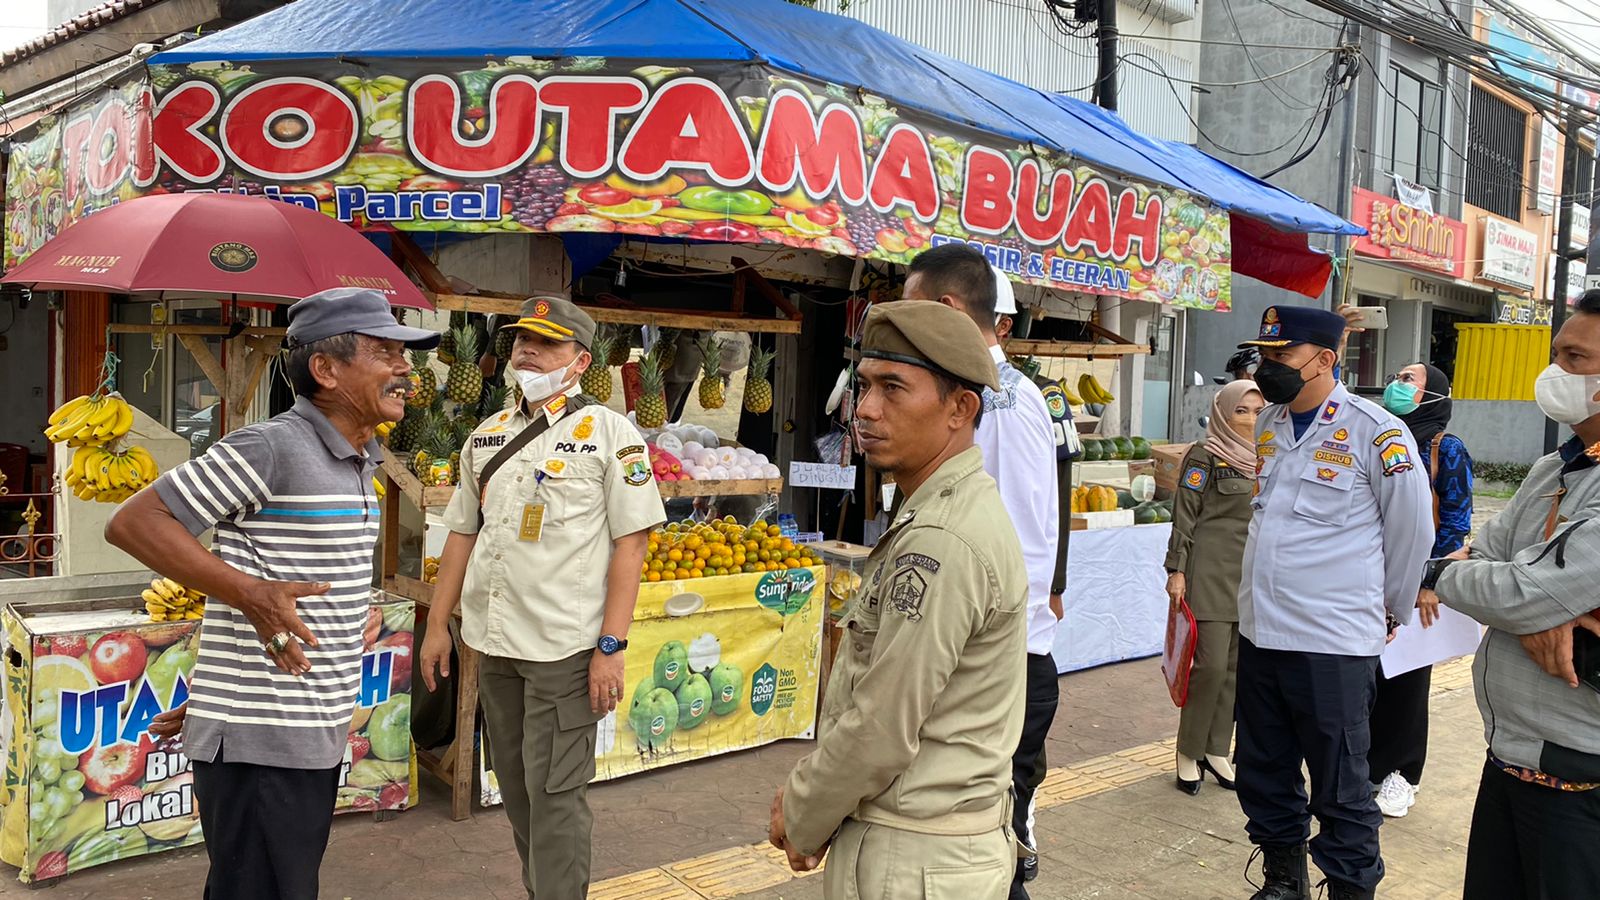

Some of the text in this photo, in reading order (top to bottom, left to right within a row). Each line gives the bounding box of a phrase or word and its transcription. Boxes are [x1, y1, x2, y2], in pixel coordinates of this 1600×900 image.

[62, 74, 1161, 266] TOKO UTAMA BUAH
[335, 183, 503, 223] Parcel
[1391, 203, 1455, 258] Shihlin
[1496, 231, 1517, 251] SINAR
[54, 255, 121, 267] MAGNUM
[1027, 251, 1045, 278] &
[1050, 256, 1131, 292] ECERAN
[336, 274, 394, 289] MAGNUM
[473, 435, 506, 448] SYARIEF
[555, 442, 597, 454] POL PP
[1316, 451, 1351, 465] DISHUB
[779, 668, 795, 677] Non
[778, 676, 797, 688] GMO
[752, 683, 774, 696] FOOD
[752, 692, 773, 704] SAFETY
[104, 783, 194, 831] Lokal
